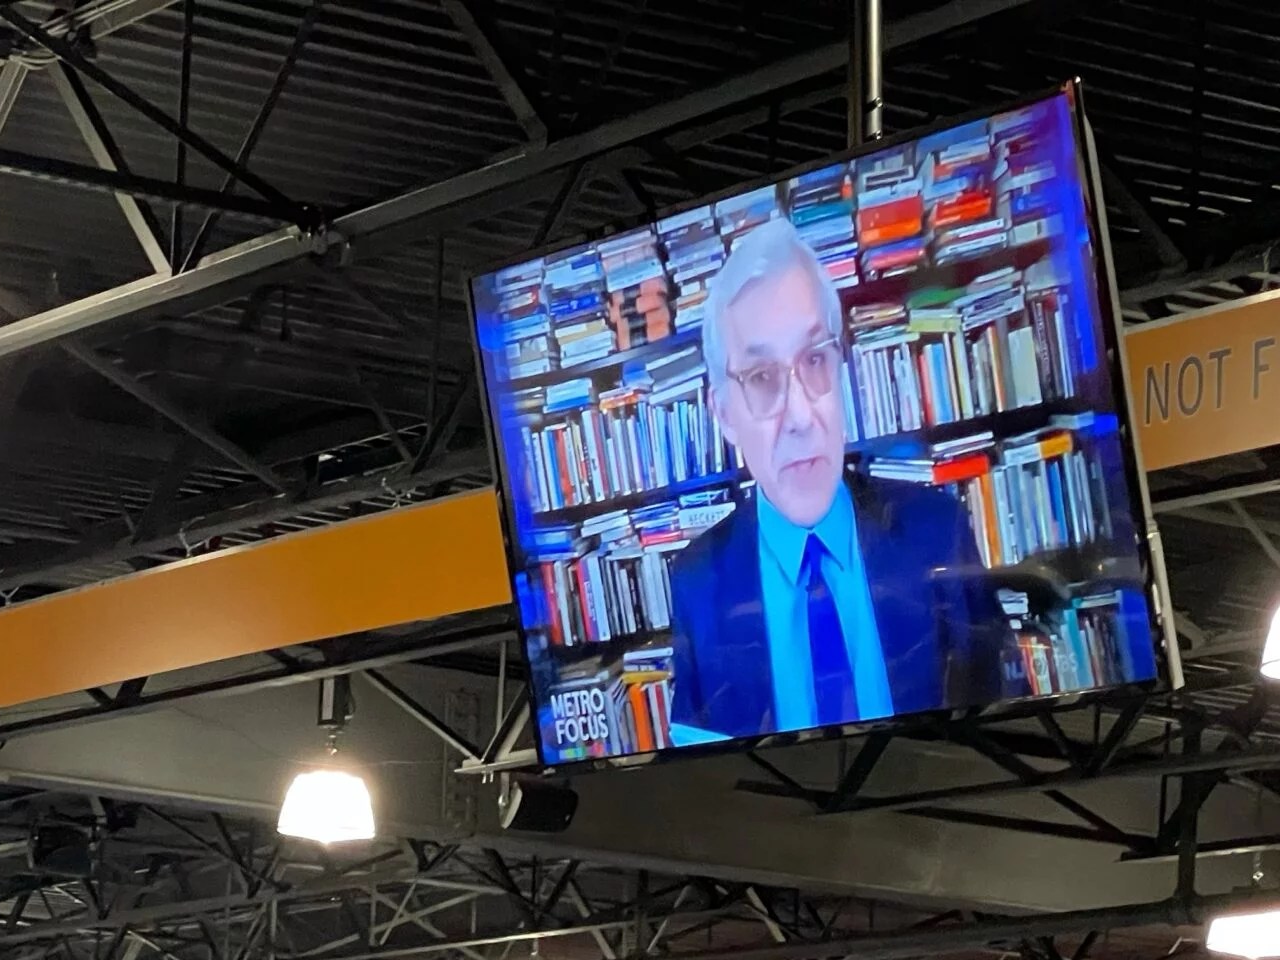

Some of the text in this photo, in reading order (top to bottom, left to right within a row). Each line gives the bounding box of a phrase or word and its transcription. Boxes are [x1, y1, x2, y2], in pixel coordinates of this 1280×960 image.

[1144, 348, 1232, 425] NOT
[550, 688, 604, 718] METRO
[556, 713, 609, 744] FOCUS
